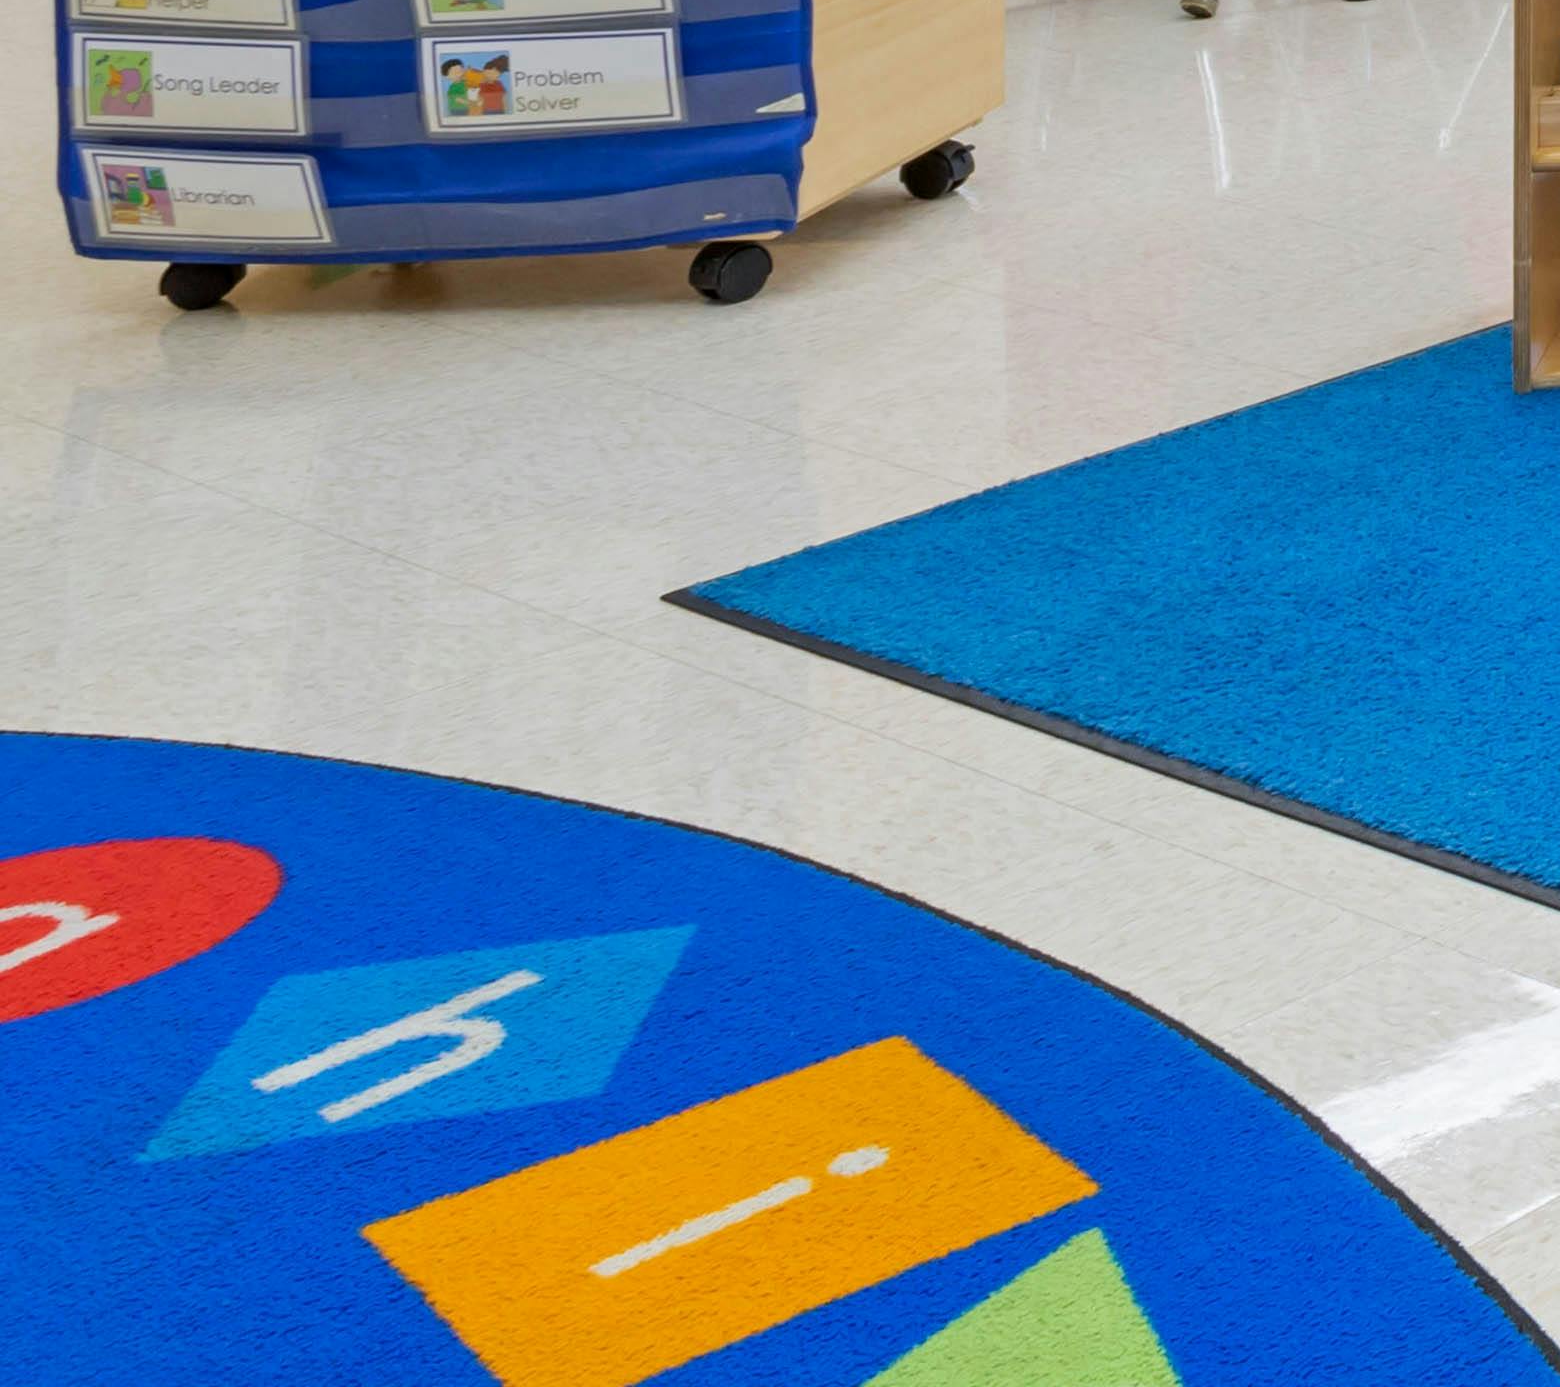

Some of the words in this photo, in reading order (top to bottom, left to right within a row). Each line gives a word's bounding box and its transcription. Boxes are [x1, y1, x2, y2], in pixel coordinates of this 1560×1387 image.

[153, 75, 204, 96] Song
[209, 76, 280, 95] Leader
[513, 67, 605, 89] Problem
[514, 94, 581, 114] Solver
[171, 187, 256, 208] Librarian
[252, 968, 544, 1122] h
